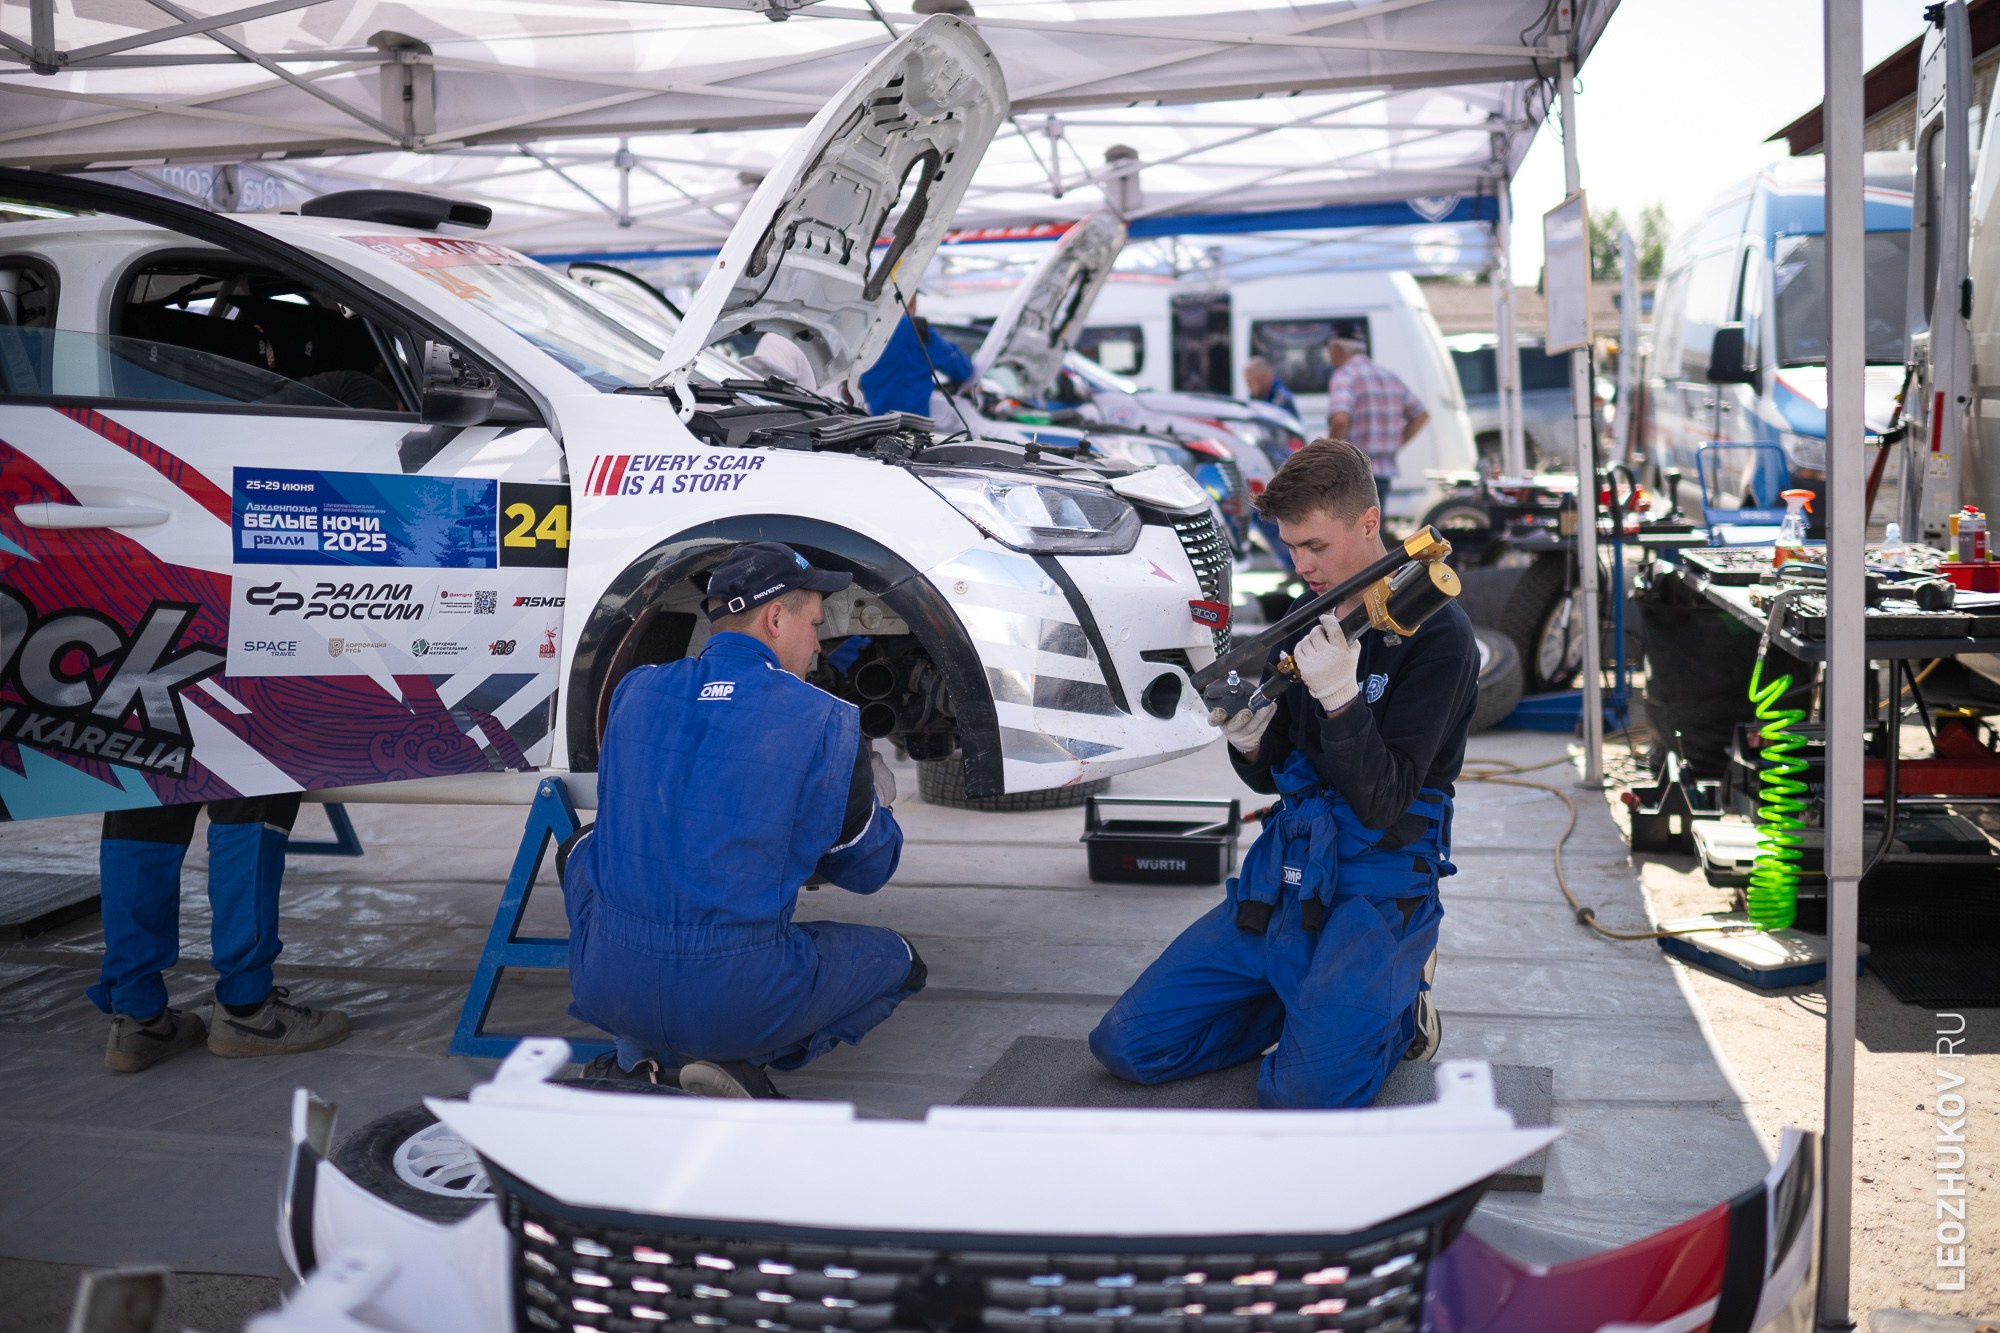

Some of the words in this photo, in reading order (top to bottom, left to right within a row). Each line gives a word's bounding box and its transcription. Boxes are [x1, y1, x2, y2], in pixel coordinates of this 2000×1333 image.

[628, 455, 702, 472] EVERY
[703, 455, 766, 470] SCAR
[246, 480, 281, 490] 25-29
[622, 475, 645, 496] IS
[648, 475, 665, 494] A
[672, 473, 748, 493] STORY
[245, 502, 317, 513] Лахденпохья
[243, 513, 318, 530] БЕЛЫЕ
[322, 515, 380, 532] НОЧИ
[503, 502, 571, 549] 24
[253, 535, 305, 549] ралли
[323, 532, 388, 552] 2025
[311, 582, 413, 601] РАЛЛИ
[753, 582, 786, 601] RAVENOL
[302, 602, 424, 620] РОССИИ
[519, 597, 566, 608] ASMG
[244, 641, 297, 652] SPACE
[491, 640, 517, 656] R8
[700, 684, 735, 698] OMP
[16, 713, 187, 774] KARELIA
[1136, 858, 1187, 871] WÜRTH
